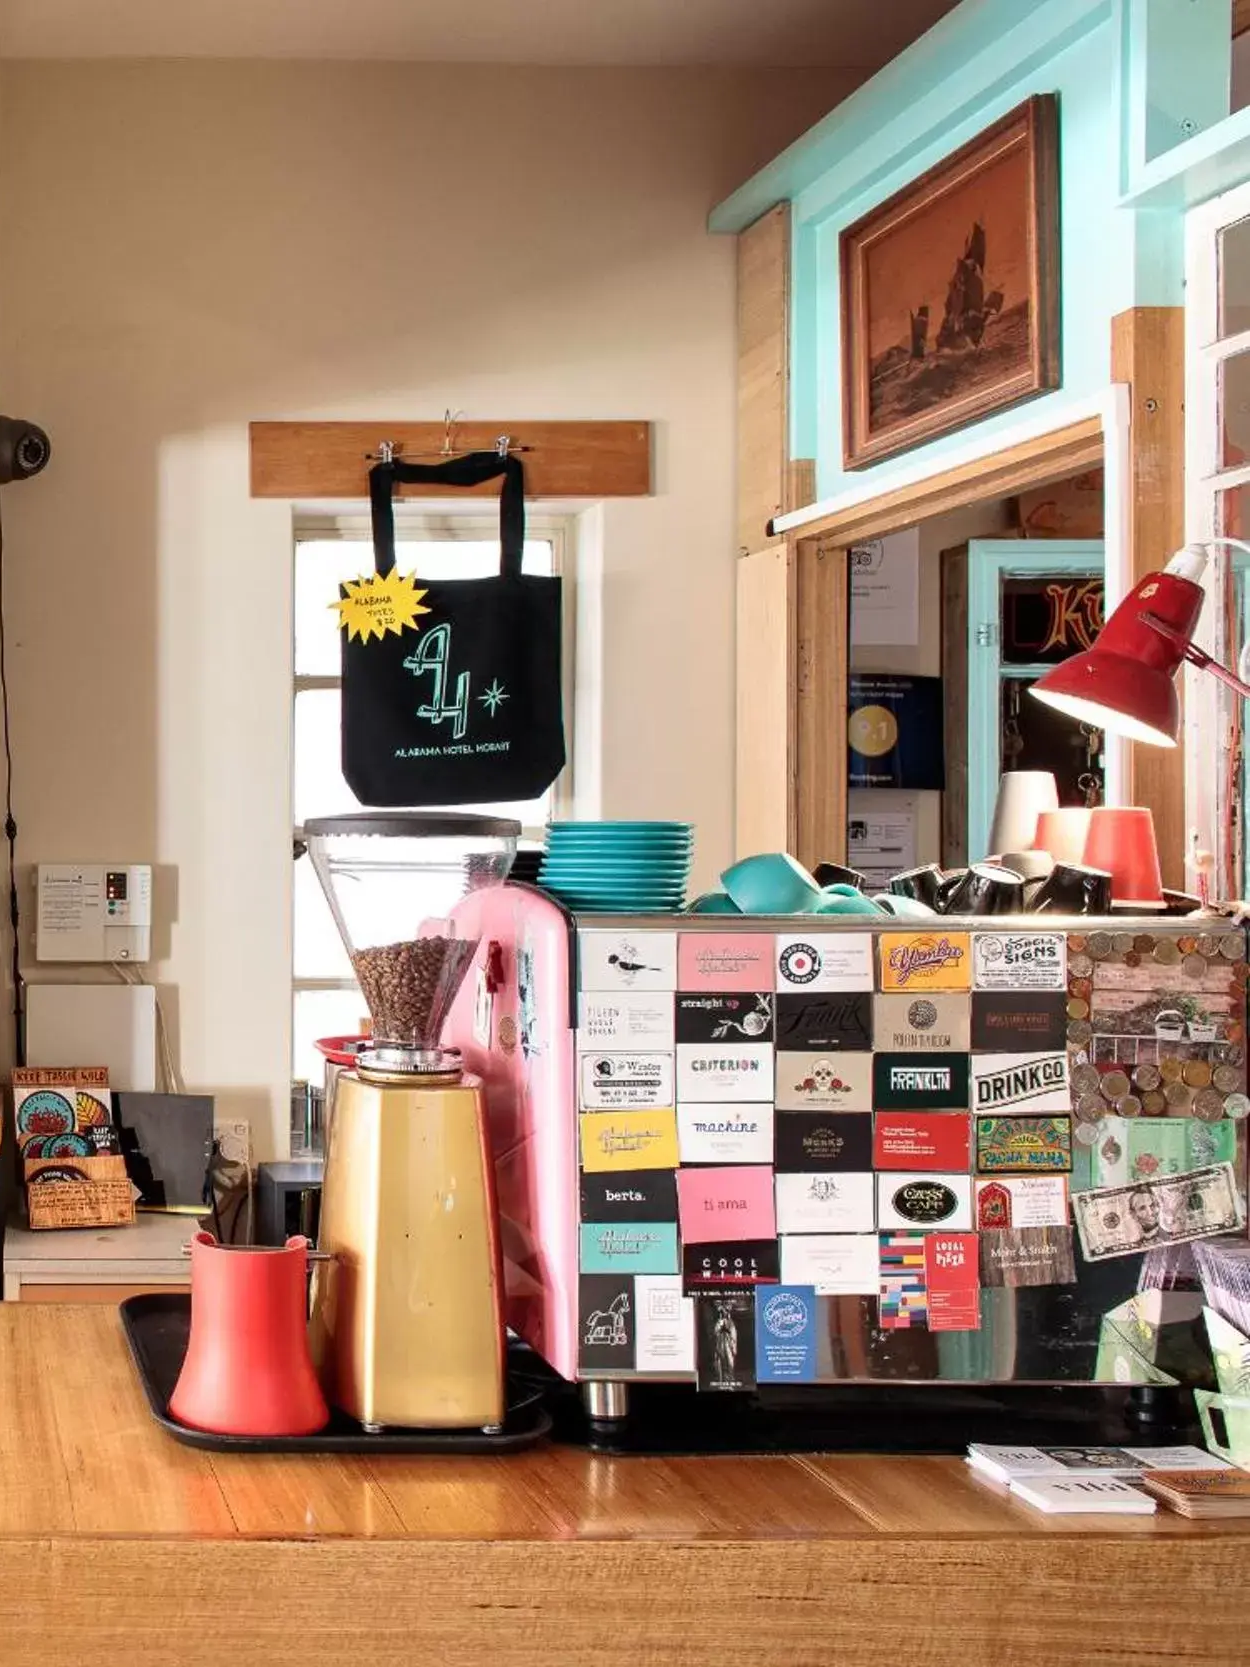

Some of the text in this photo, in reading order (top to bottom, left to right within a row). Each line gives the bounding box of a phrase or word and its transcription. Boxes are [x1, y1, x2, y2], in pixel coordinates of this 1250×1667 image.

[394, 741, 512, 758] ALABAMA HOTEL HOBART
[1003, 946, 1057, 965] SIGNS
[680, 998, 723, 1010] straight
[690, 1059, 760, 1073] CRITERION
[890, 1066, 951, 1091] FRANKLIN
[692, 1120, 759, 1134] machine
[605, 1189, 647, 1202] berta.
[703, 1199, 749, 1211] ti ama
[935, 1241, 966, 1251] LOCAL
[702, 1258, 759, 1269] COOL
[935, 1252, 966, 1268] PIZZA
